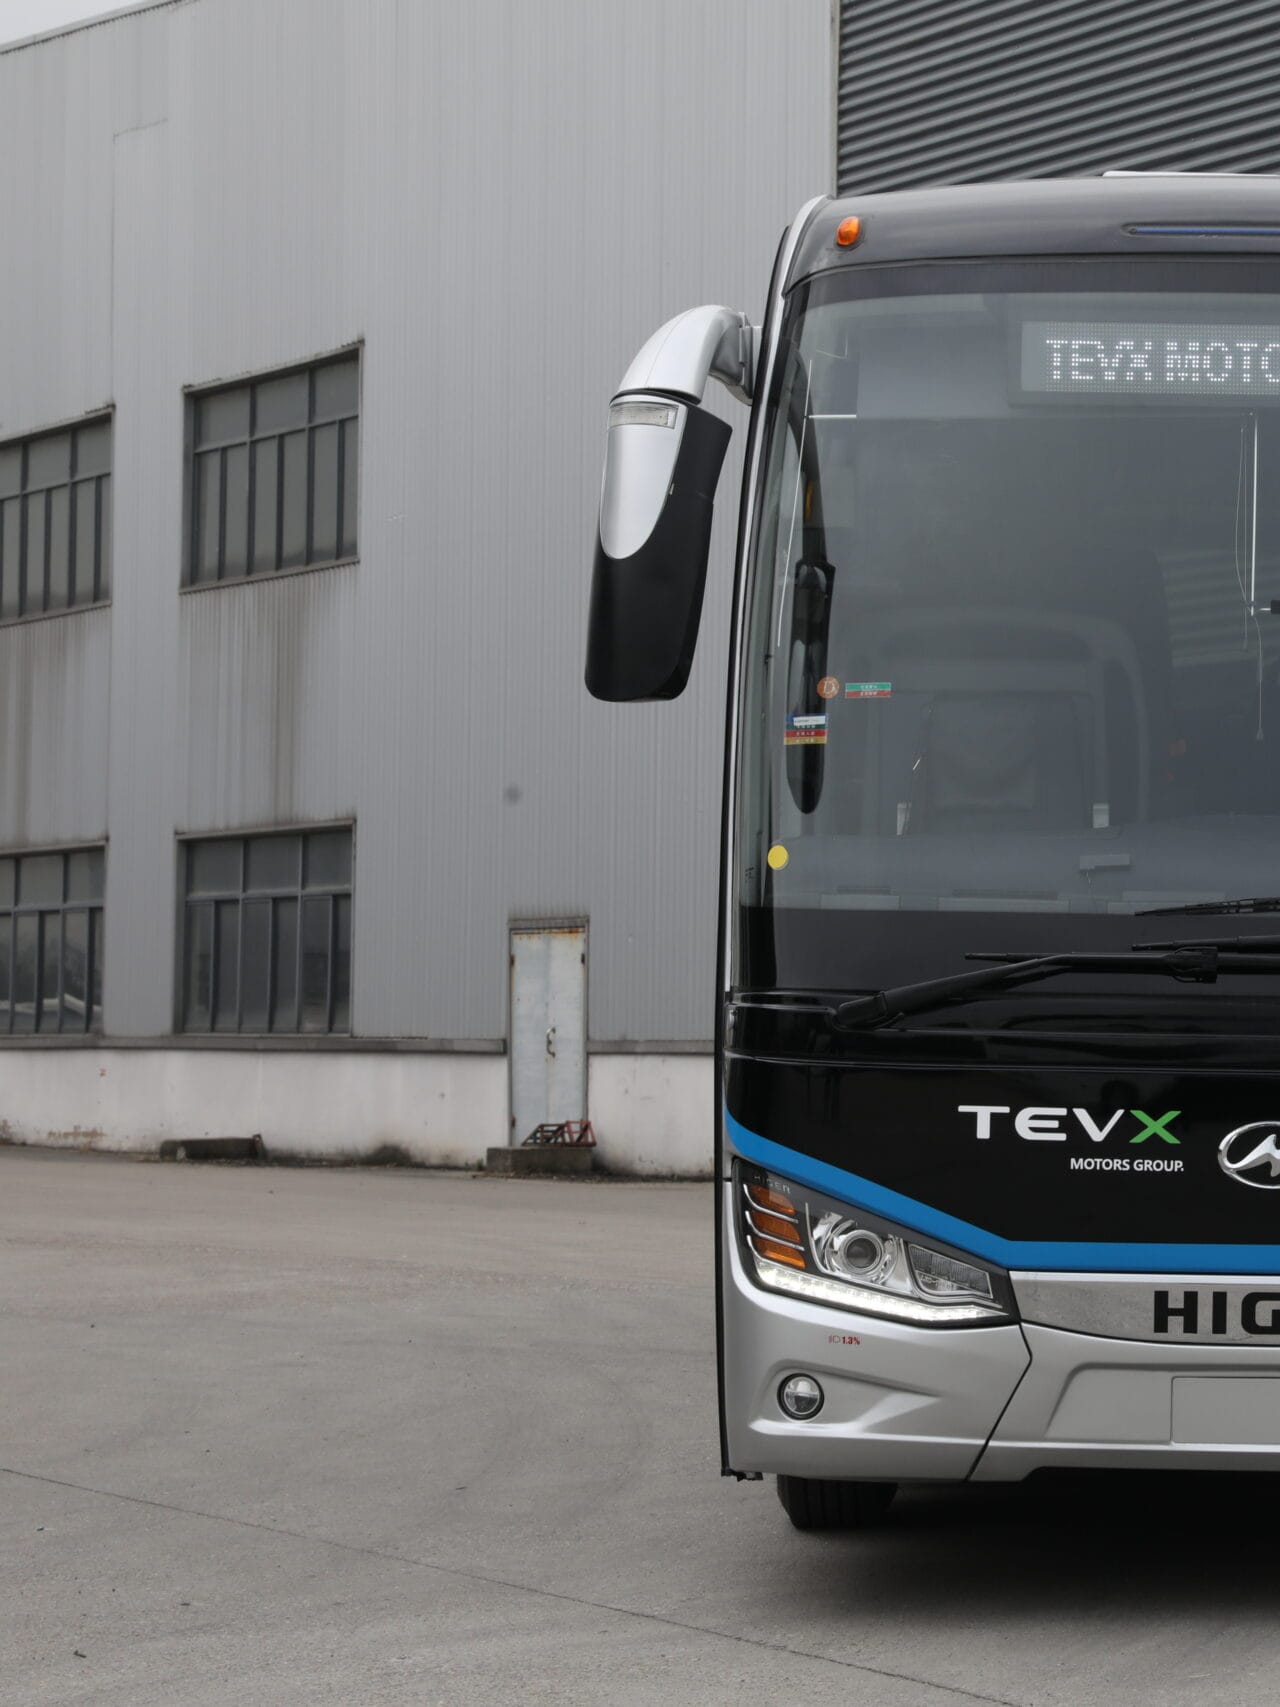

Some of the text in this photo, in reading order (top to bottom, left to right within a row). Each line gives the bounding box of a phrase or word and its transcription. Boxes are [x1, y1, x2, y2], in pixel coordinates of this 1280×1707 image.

[1046, 340, 1152, 381] TEVX
[957, 1104, 1183, 1144] TEVX
[1069, 1157, 1185, 1172] MOTORS GROUP.
